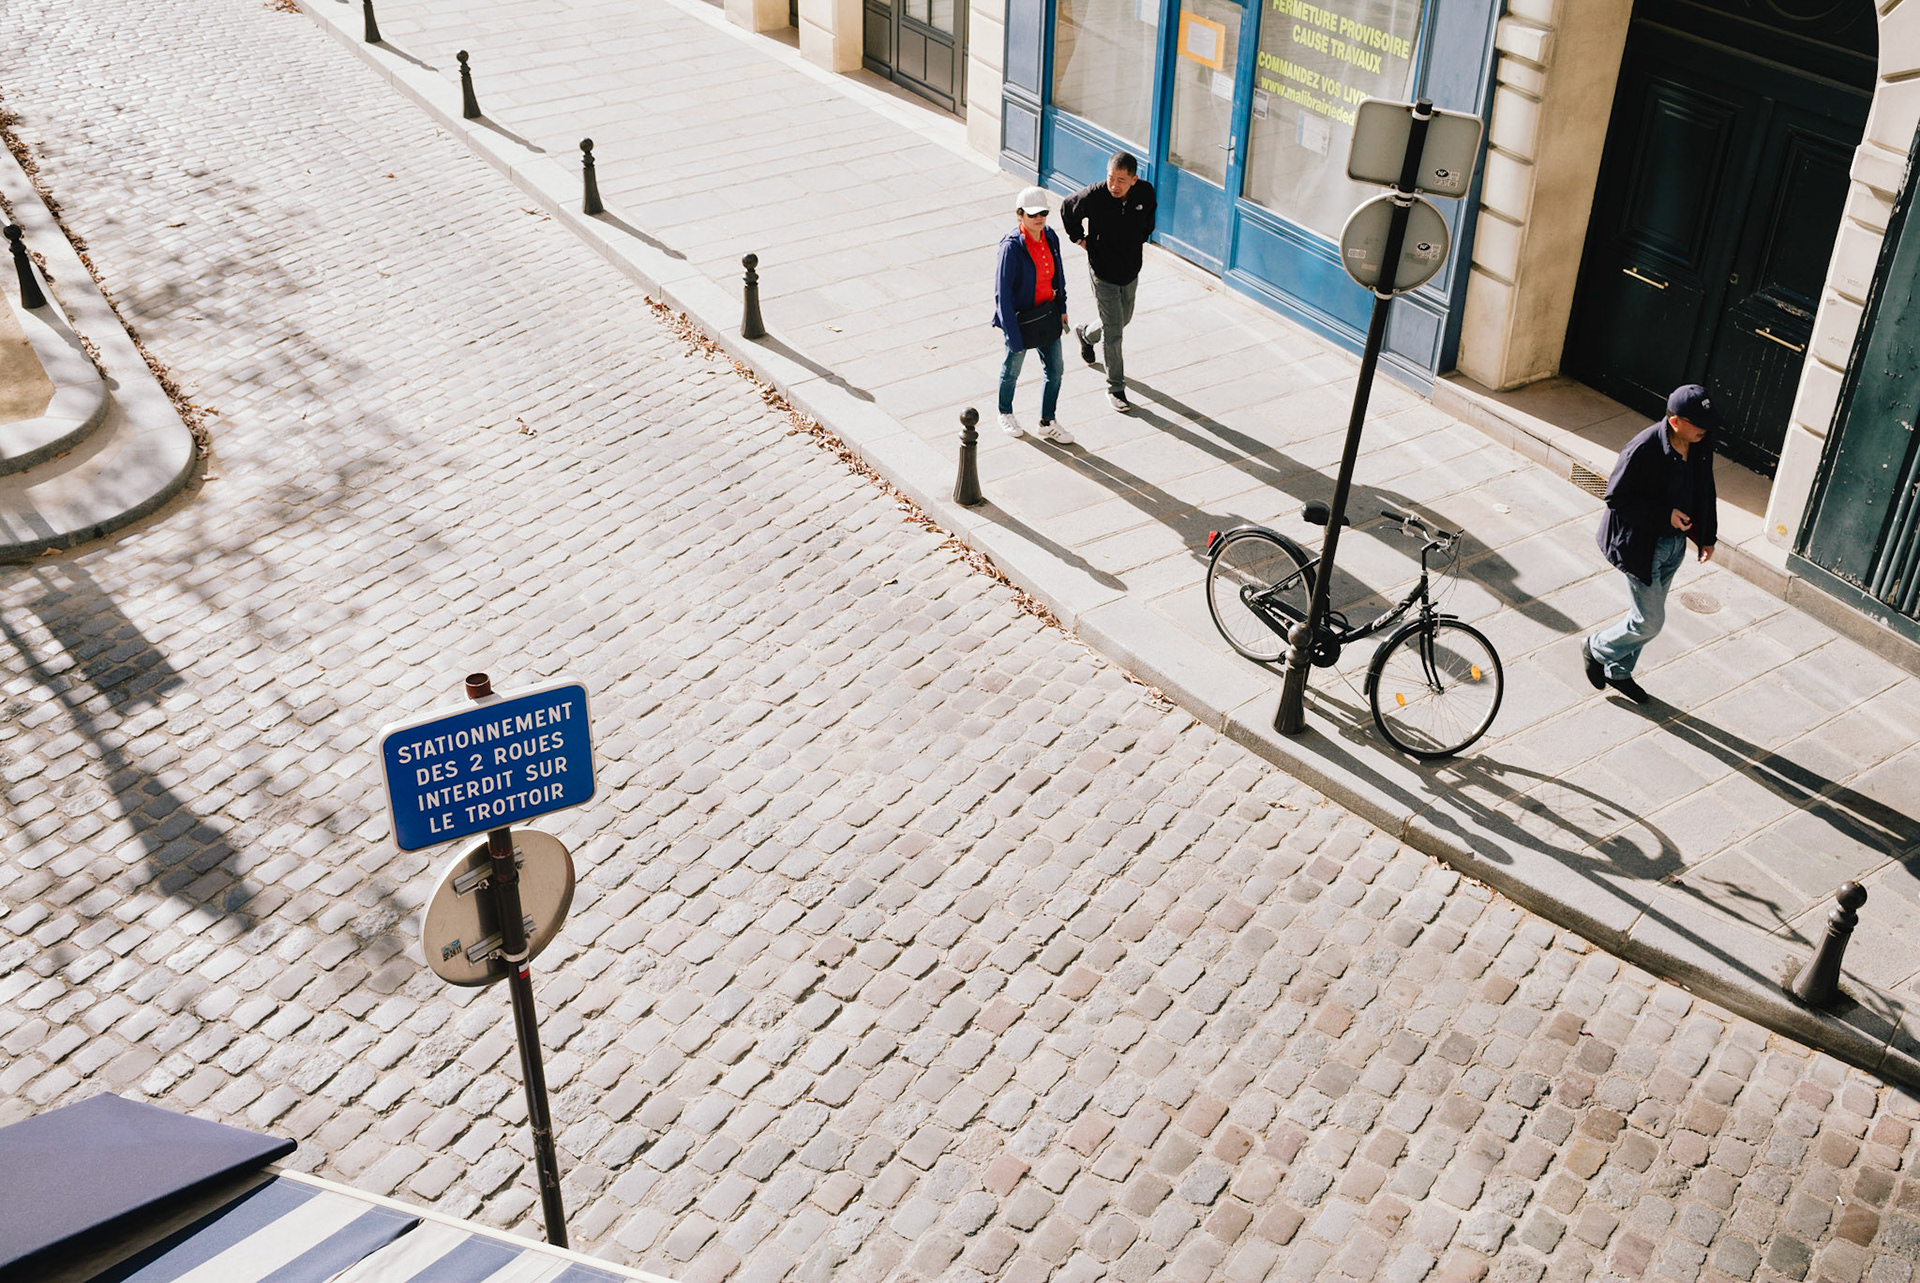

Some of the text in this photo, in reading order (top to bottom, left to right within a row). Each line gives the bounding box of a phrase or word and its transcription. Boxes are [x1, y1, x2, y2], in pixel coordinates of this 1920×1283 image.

[1272, 0, 1411, 60] FERMETURE PROVISOIRE
[1292, 24, 1383, 74] CAUSE TRAVAUX
[1258, 51, 1321, 90] COMMANDEZ
[1321, 75, 1342, 99] VOS
[397, 701, 573, 764] STATIONNEMENT
[416, 731, 564, 787] DES 2 ROUES
[417, 756, 568, 812] INTERDIT SUR
[429, 783, 564, 834] LE TROTTOIR
